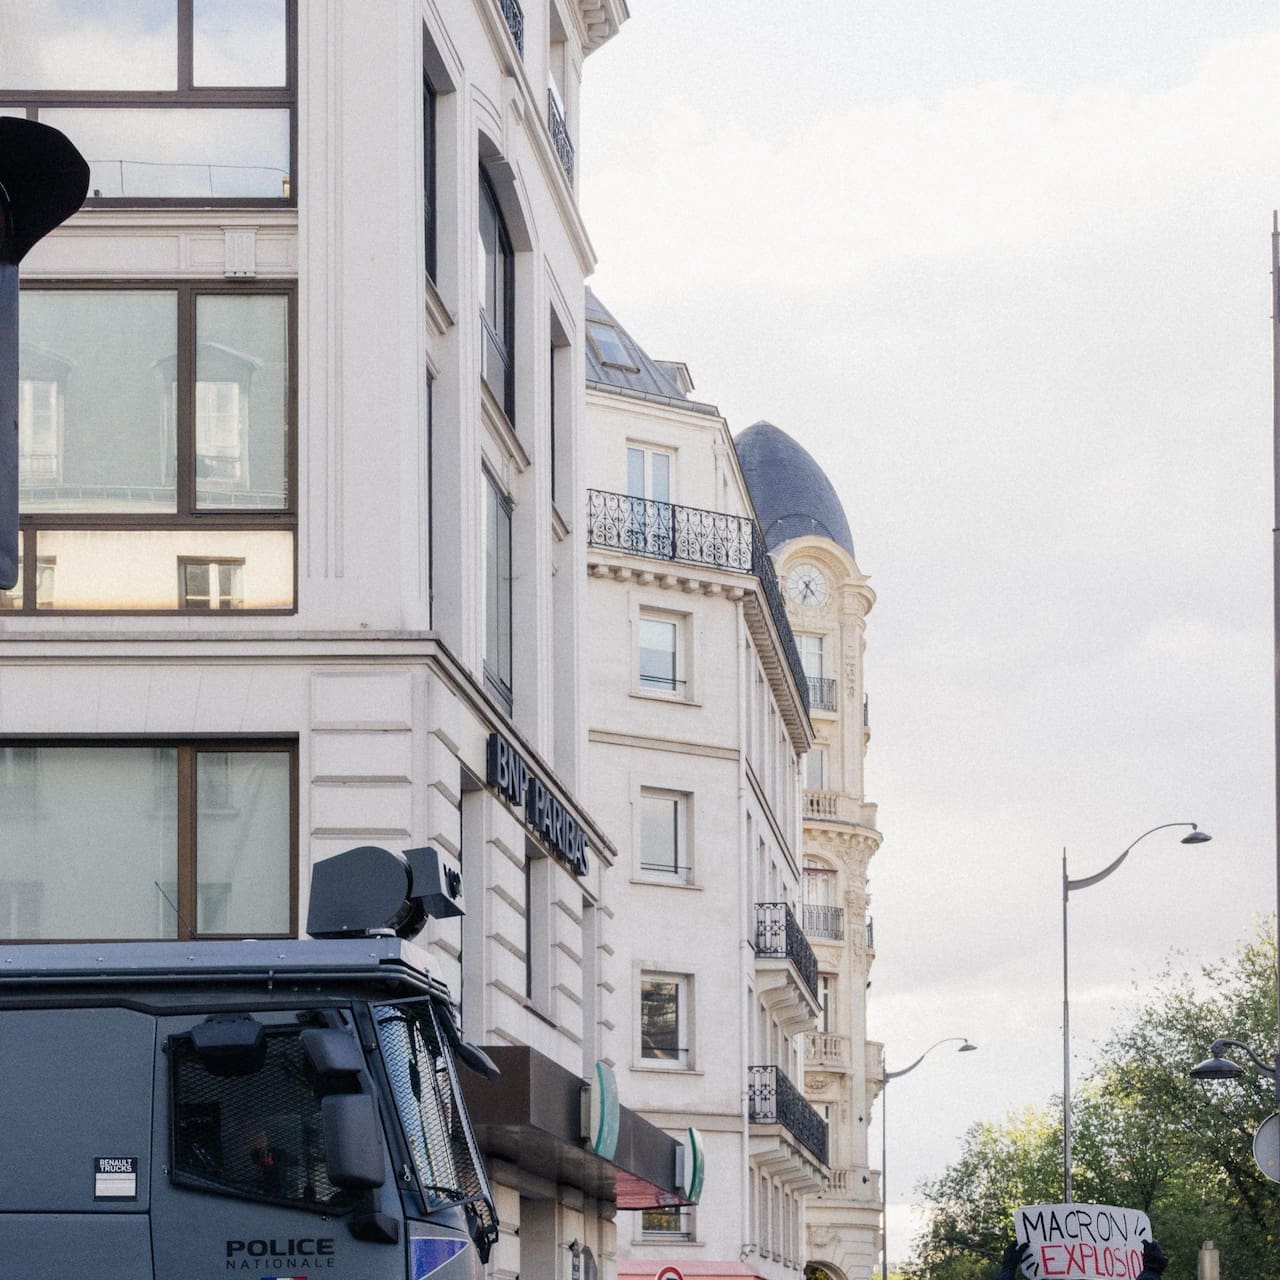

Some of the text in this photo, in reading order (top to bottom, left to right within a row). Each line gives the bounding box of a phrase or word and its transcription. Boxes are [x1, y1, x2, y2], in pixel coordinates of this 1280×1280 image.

[489, 732, 589, 876] BNP PARIBAS
[99, 1158, 132, 1166] RENAULT
[1022, 1210, 1128, 1243] MACRON
[226, 1239, 335, 1257] POLICE
[226, 1258, 335, 1269] NATIONALE
